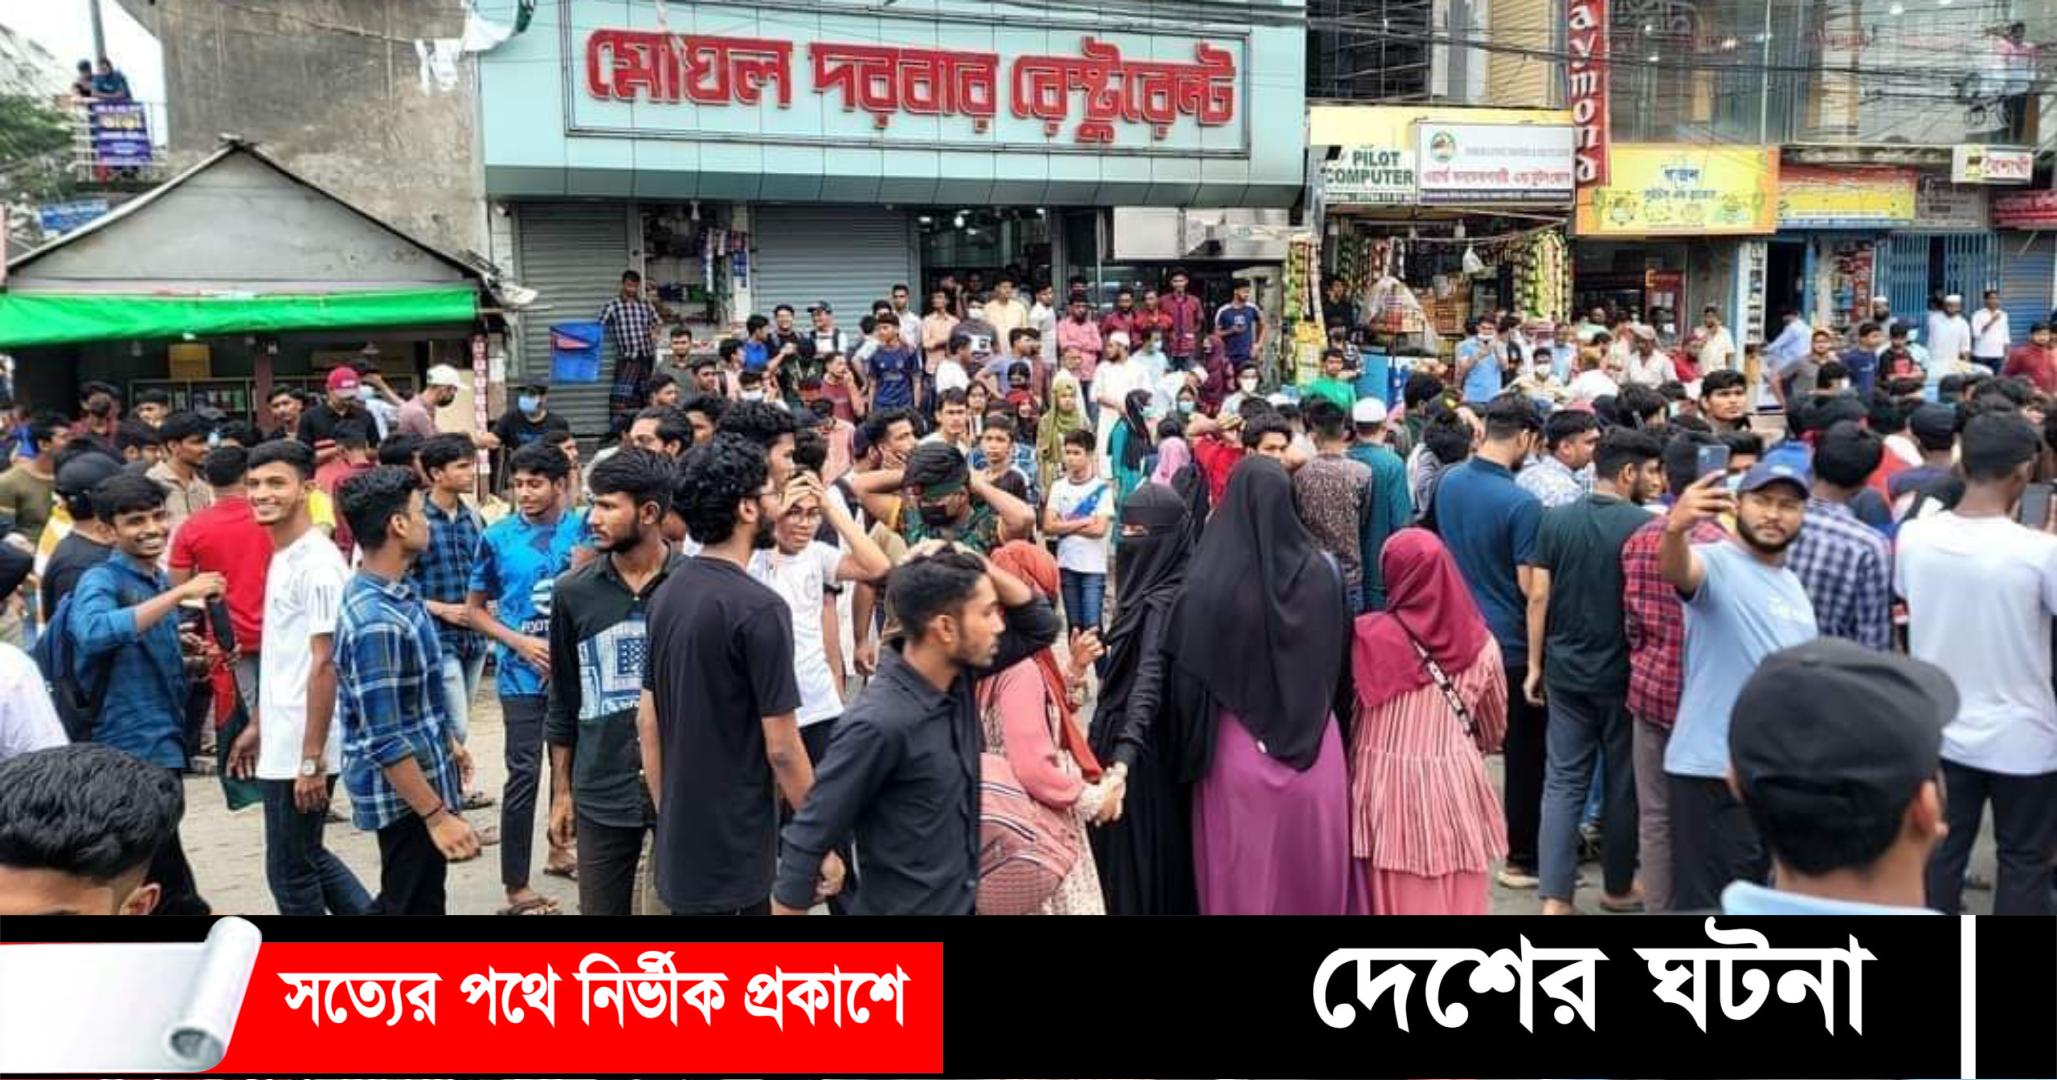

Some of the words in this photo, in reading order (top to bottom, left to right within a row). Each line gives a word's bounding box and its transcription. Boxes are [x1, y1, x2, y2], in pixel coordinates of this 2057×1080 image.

[808, 43, 999, 132] দরবার
[1352, 150, 1401, 167] PILOT
[1326, 168, 1415, 185] COMPUTER
